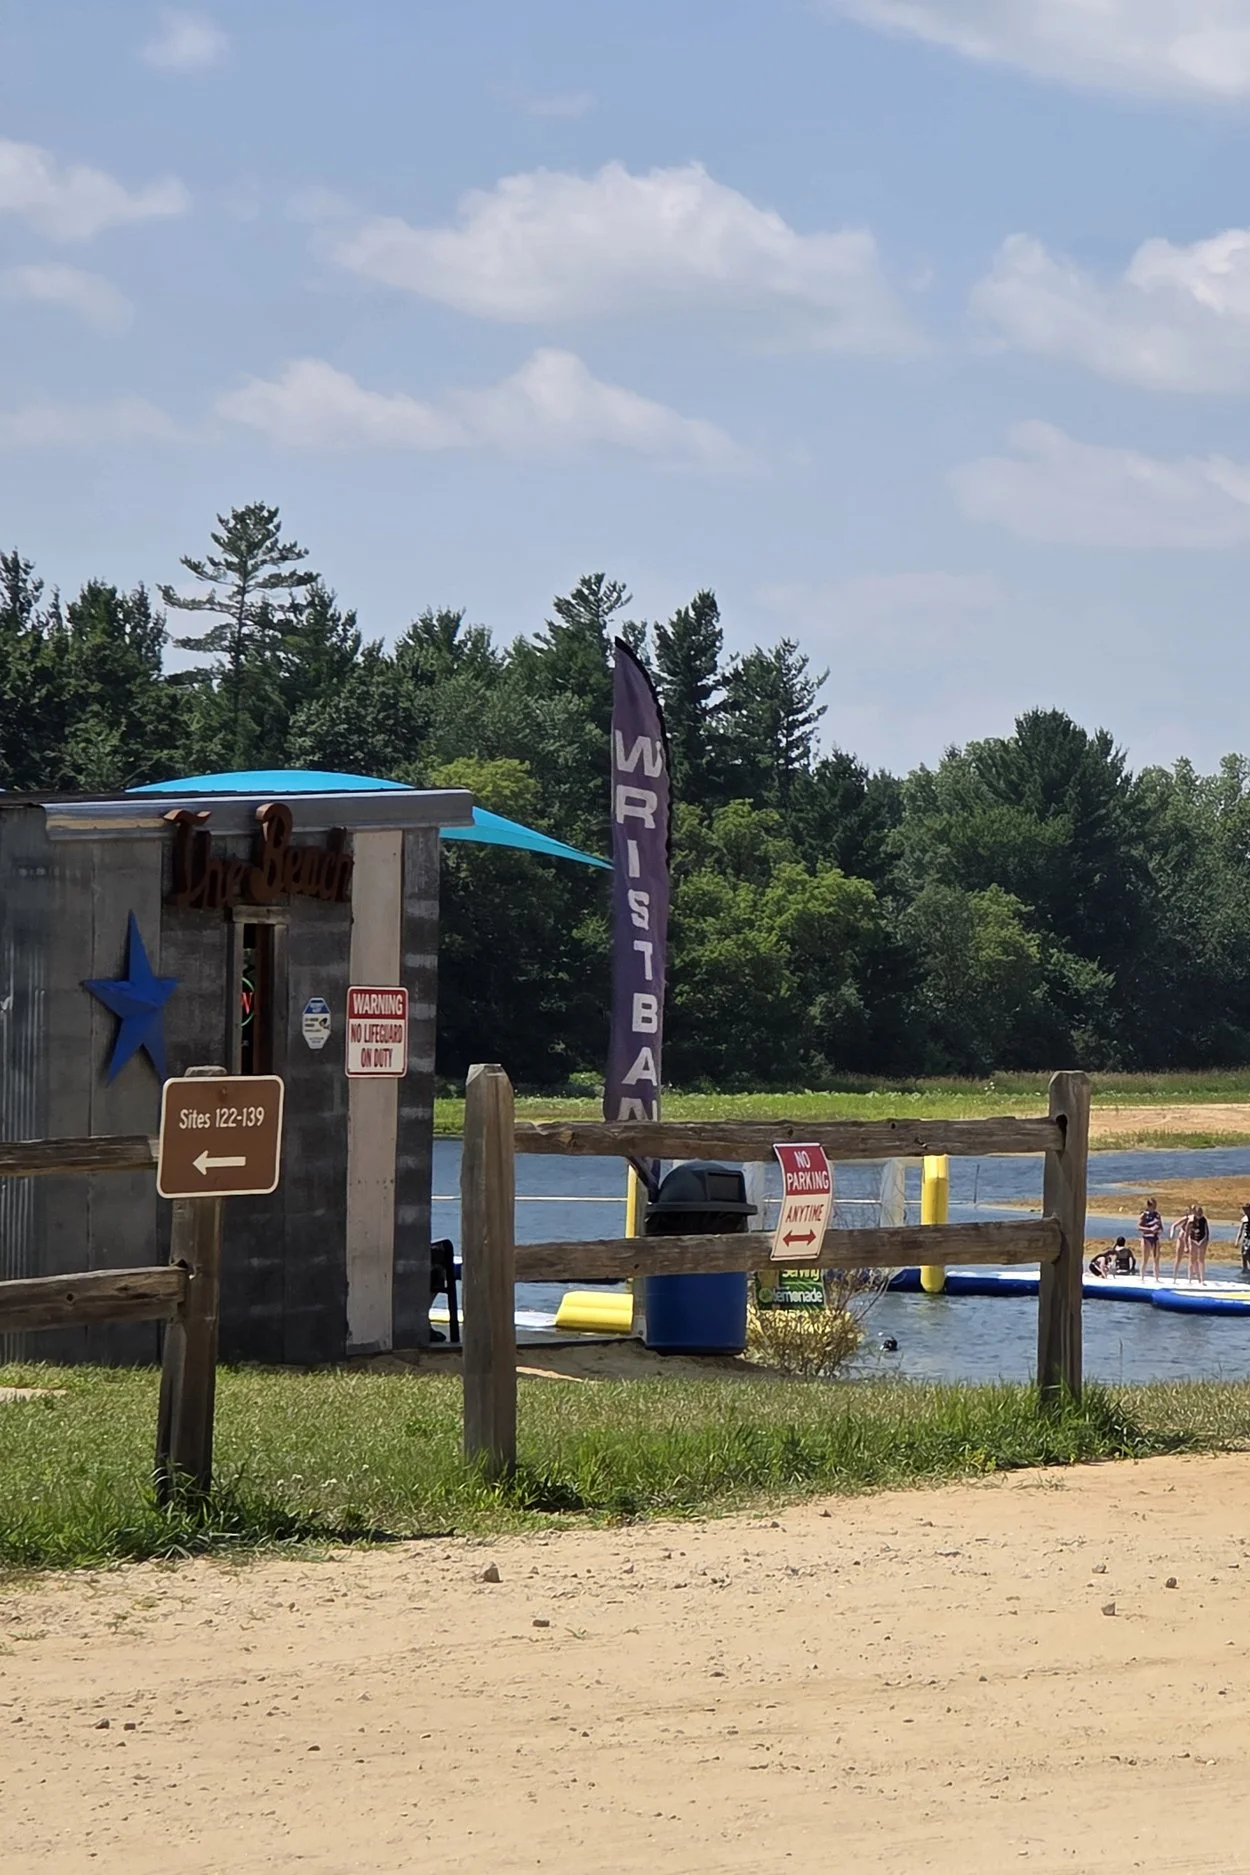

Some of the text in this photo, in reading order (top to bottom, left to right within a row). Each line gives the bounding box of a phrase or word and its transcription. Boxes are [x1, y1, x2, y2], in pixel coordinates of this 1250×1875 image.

[163, 803, 354, 909] The Beach
[353, 993, 403, 1015] WARNING
[351, 1024, 402, 1043] NO LIFEGUARD
[361, 1048, 393, 1067] ON DUTY
[179, 1107, 265, 1129] Sites 122-139
[794, 1150, 811, 1169] NO
[787, 1171, 829, 1191] PARKING
[785, 1204, 825, 1223] ANYTIME
